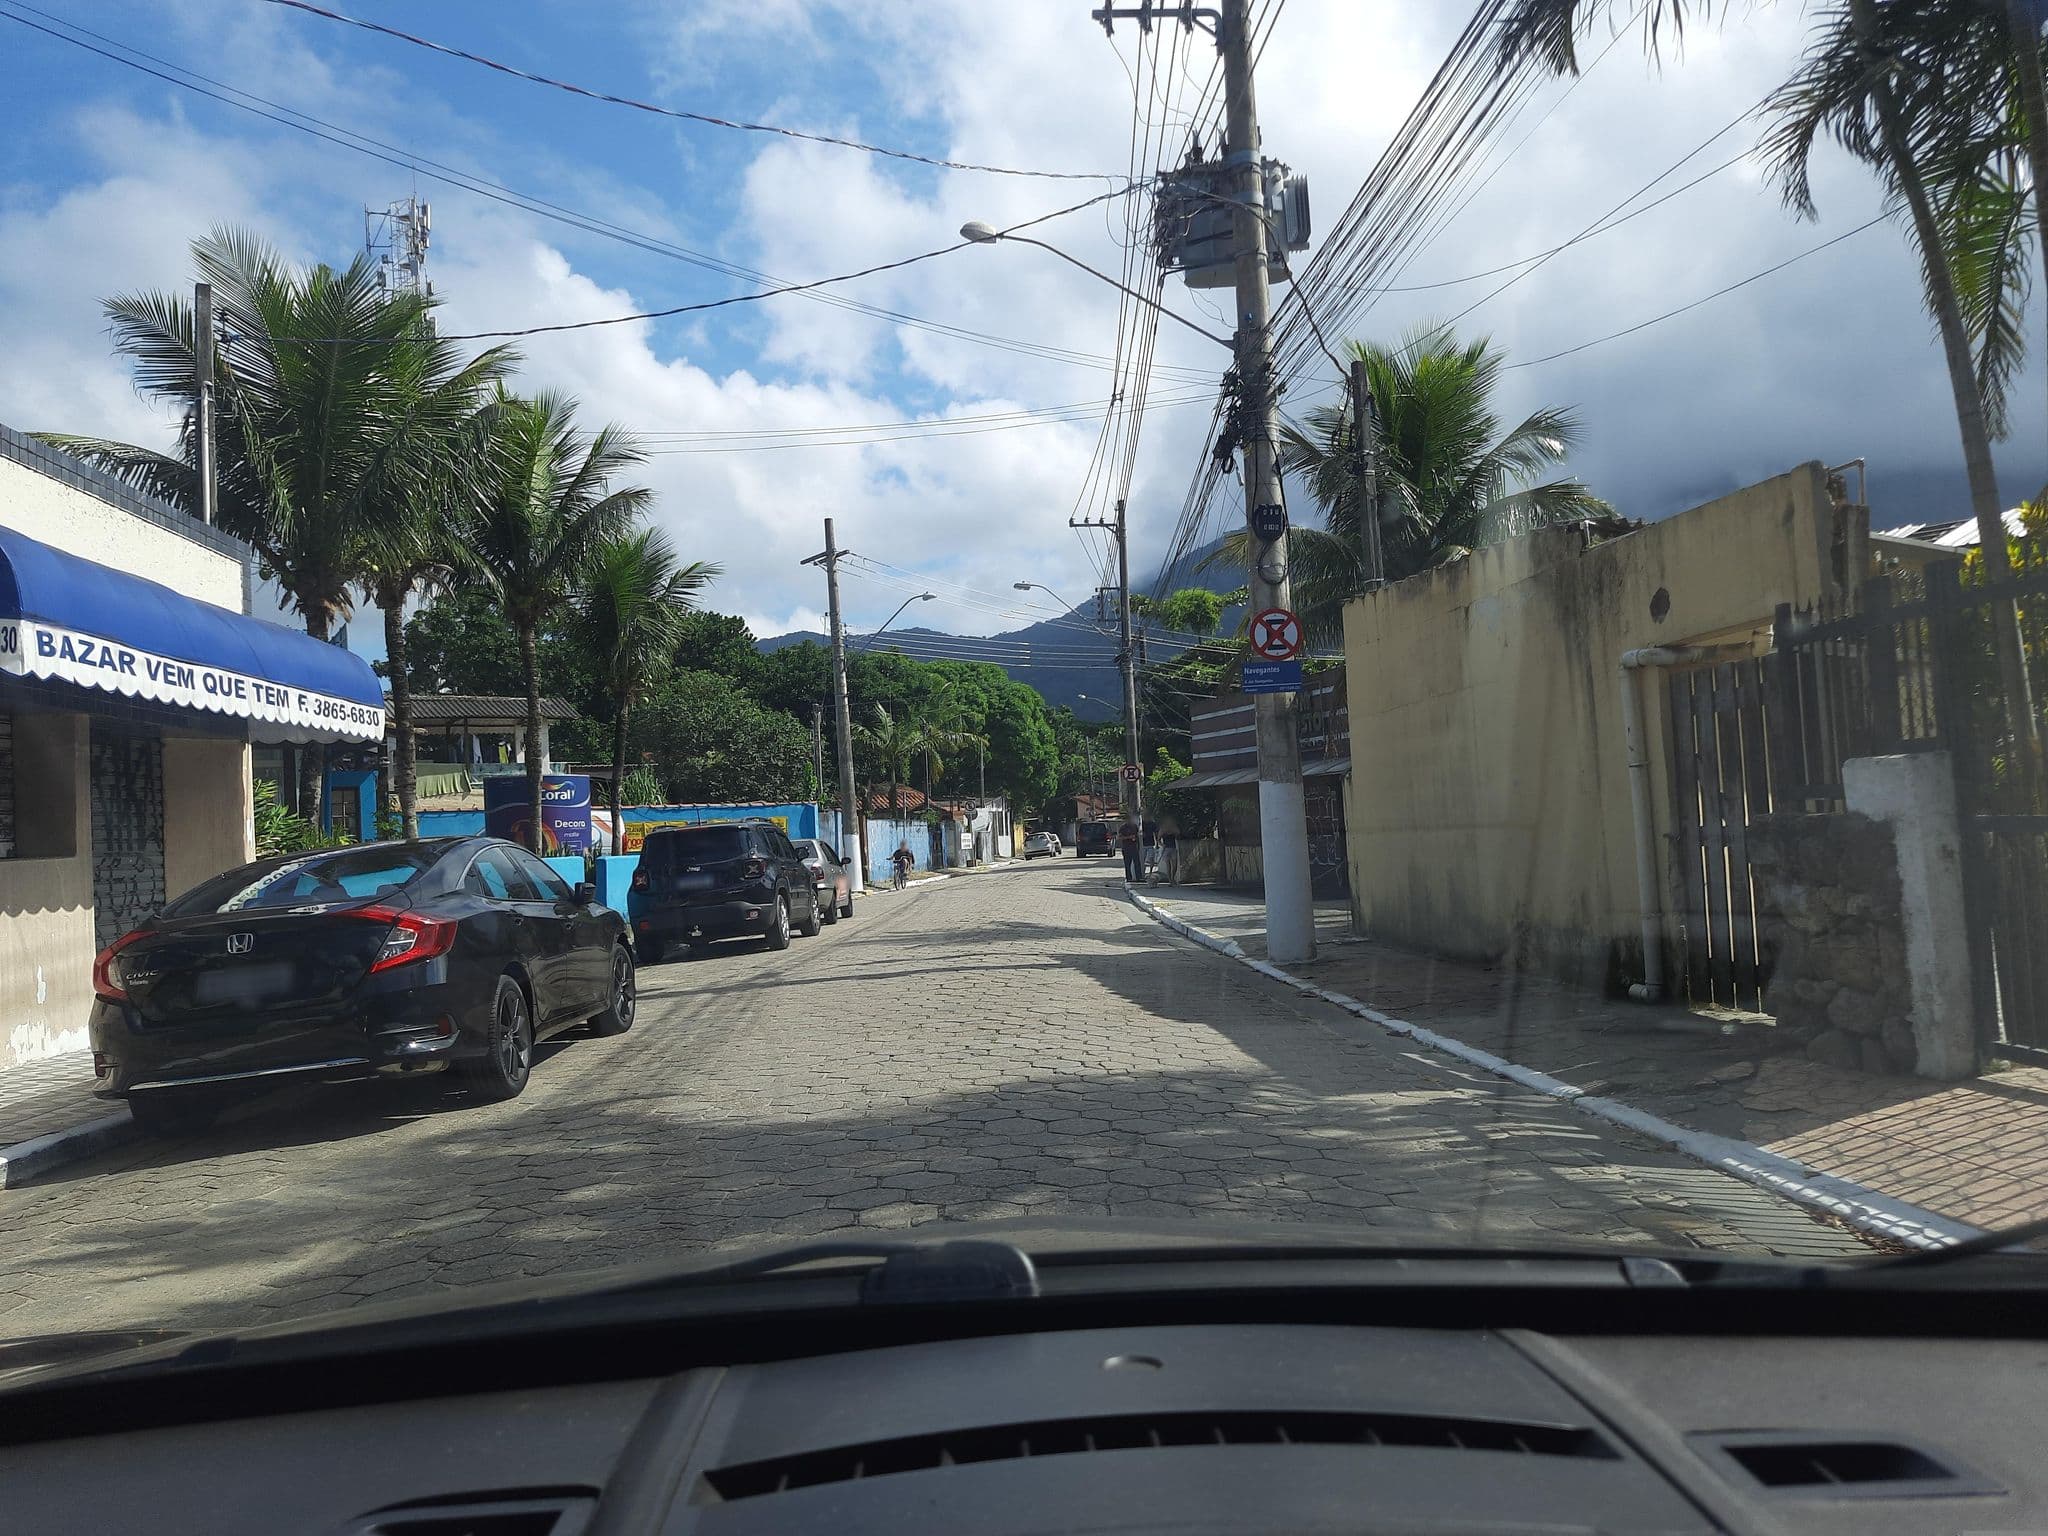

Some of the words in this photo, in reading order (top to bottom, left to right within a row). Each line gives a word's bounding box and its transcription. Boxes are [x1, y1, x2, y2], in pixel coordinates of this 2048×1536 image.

[1, 626, 17, 653] 30
[36, 630, 137, 676] BAZAR
[144, 657, 195, 690] VEM
[202, 672, 247, 700] QUE
[252, 683, 289, 709] TEM
[313, 698, 380, 727] 3865-6830
[1244, 666, 1280, 676] Navegantes
